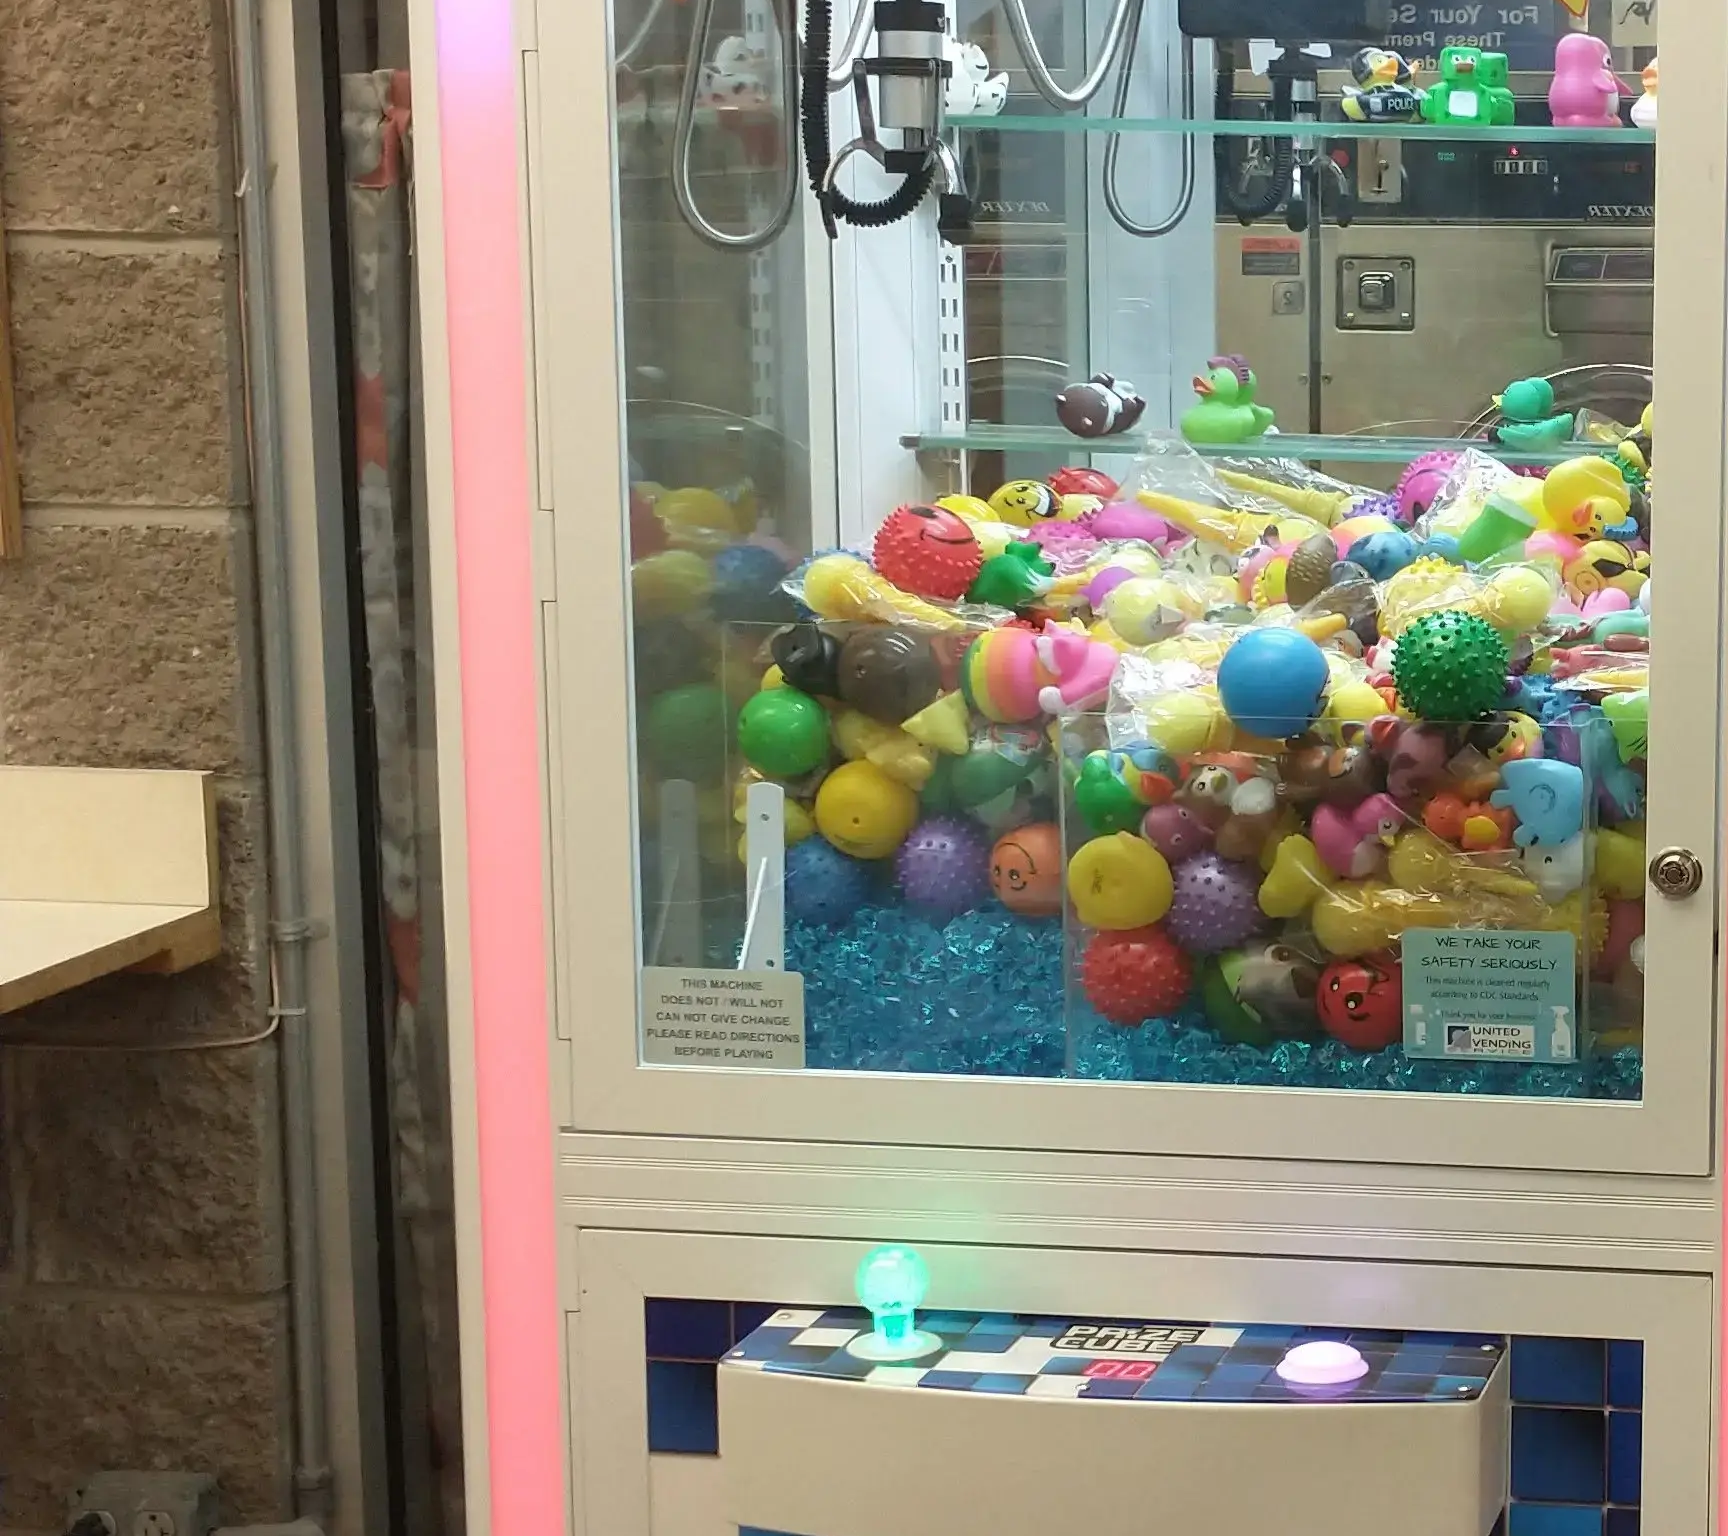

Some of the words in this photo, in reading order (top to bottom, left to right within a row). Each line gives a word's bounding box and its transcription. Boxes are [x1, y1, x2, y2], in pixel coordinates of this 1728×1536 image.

[1435, 935, 1458, 948] WE
[1464, 936, 1500, 949] TAKE
[1504, 938, 1542, 950] YOUR
[1421, 956, 1476, 968] SAFETY
[1480, 958, 1558, 970] SERIOUSLY
[681, 978, 707, 990] THIS
[710, 979, 764, 991] MACHINE
[661, 995, 692, 1006] DOES
[696, 996, 721, 1006] NOT
[729, 998, 757, 1008] WILL
[760, 999, 784, 1009] NOT
[656, 1012, 680, 1022] CAN
[684, 1013, 706, 1023] NOT
[711, 1014, 738, 1025] GIVE
[741, 1015, 791, 1026] CHANGE
[647, 1028, 692, 1039] PLEASE
[695, 1030, 727, 1041] READ
[730, 1031, 800, 1044] DIRECTIONS
[1472, 1026, 1521, 1037] UNITED
[1472, 1038, 1532, 1049] VENDING
[674, 1046, 720, 1058] BEFORE
[724, 1048, 773, 1060] PLAYING
[1065, 1325, 1206, 1343] PRIZE
[1054, 1337, 1181, 1353] CUBE
